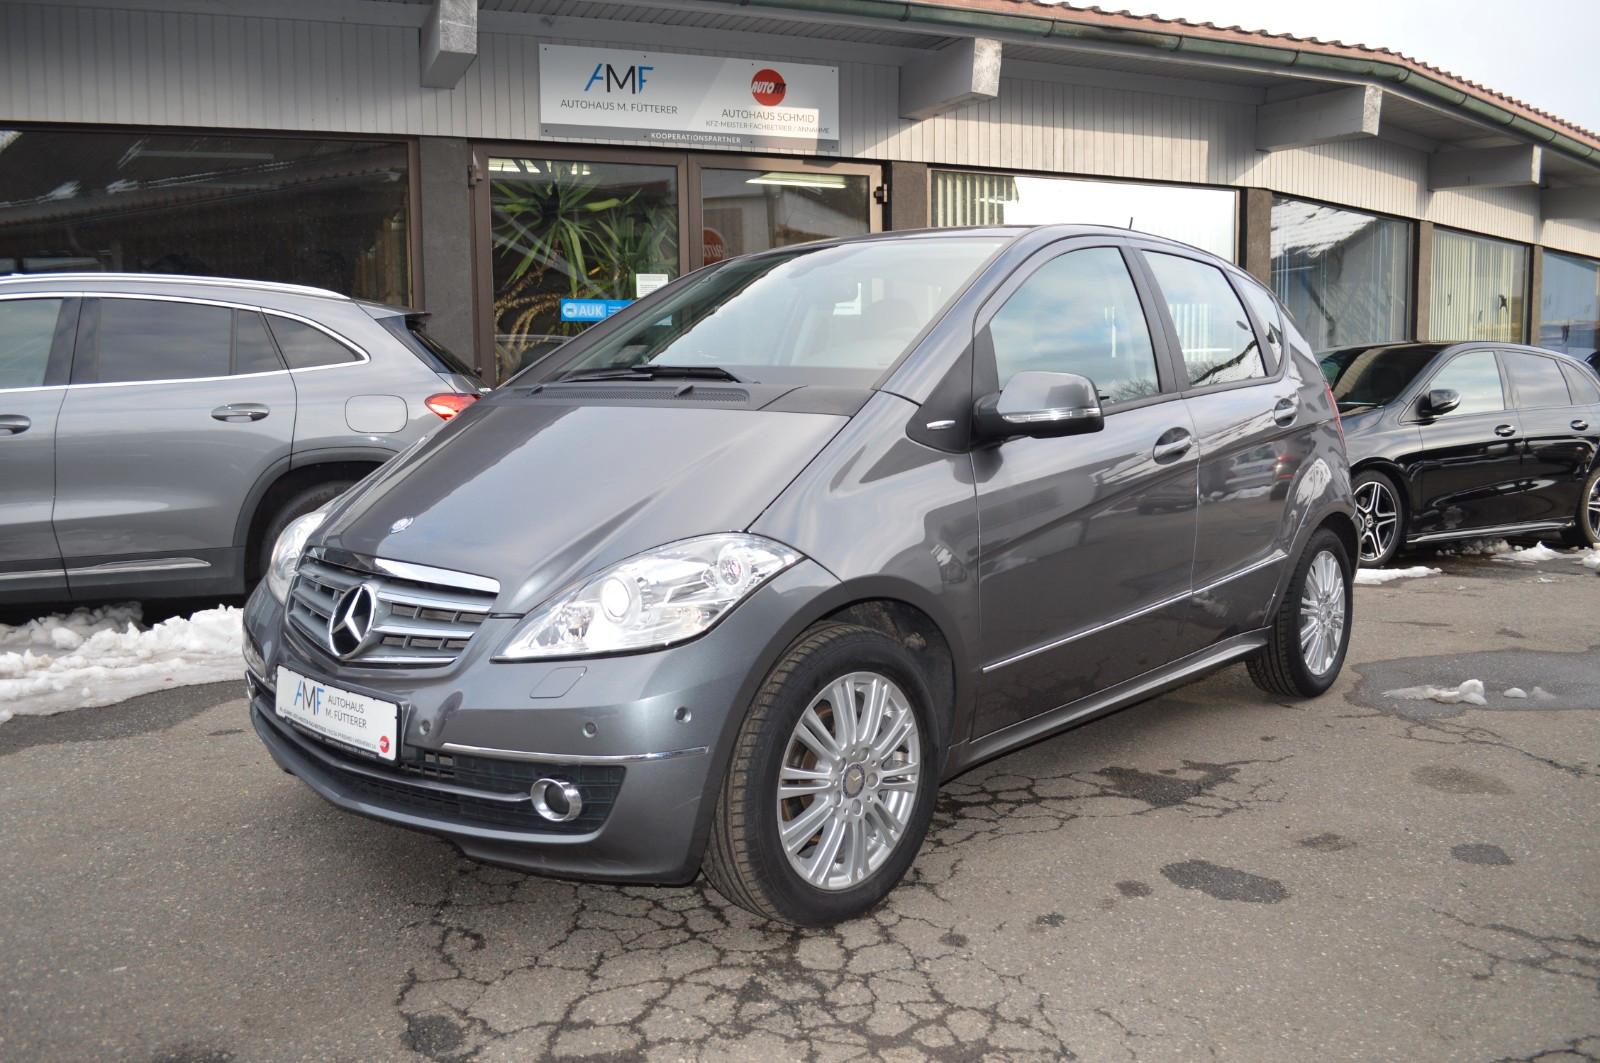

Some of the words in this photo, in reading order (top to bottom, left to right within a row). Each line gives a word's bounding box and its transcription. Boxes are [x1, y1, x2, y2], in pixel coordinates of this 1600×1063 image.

[584, 63, 654, 94] AMF
[560, 99, 615, 111] AUTOHAUS
[617, 103, 628, 112] M.
[631, 102, 678, 114] FÜTTERER
[721, 109, 775, 121] AUTOHAUS
[777, 112, 815, 124] SCHMID
[651, 132, 741, 143] KOOPERATIONSPARTNER
[578, 304, 603, 317] AUK
[294, 680, 325, 716] AMF
[328, 695, 365, 713] AUTOHAUS
[325, 708, 333, 719] M.
[334, 710, 367, 729] FÜTTERER
